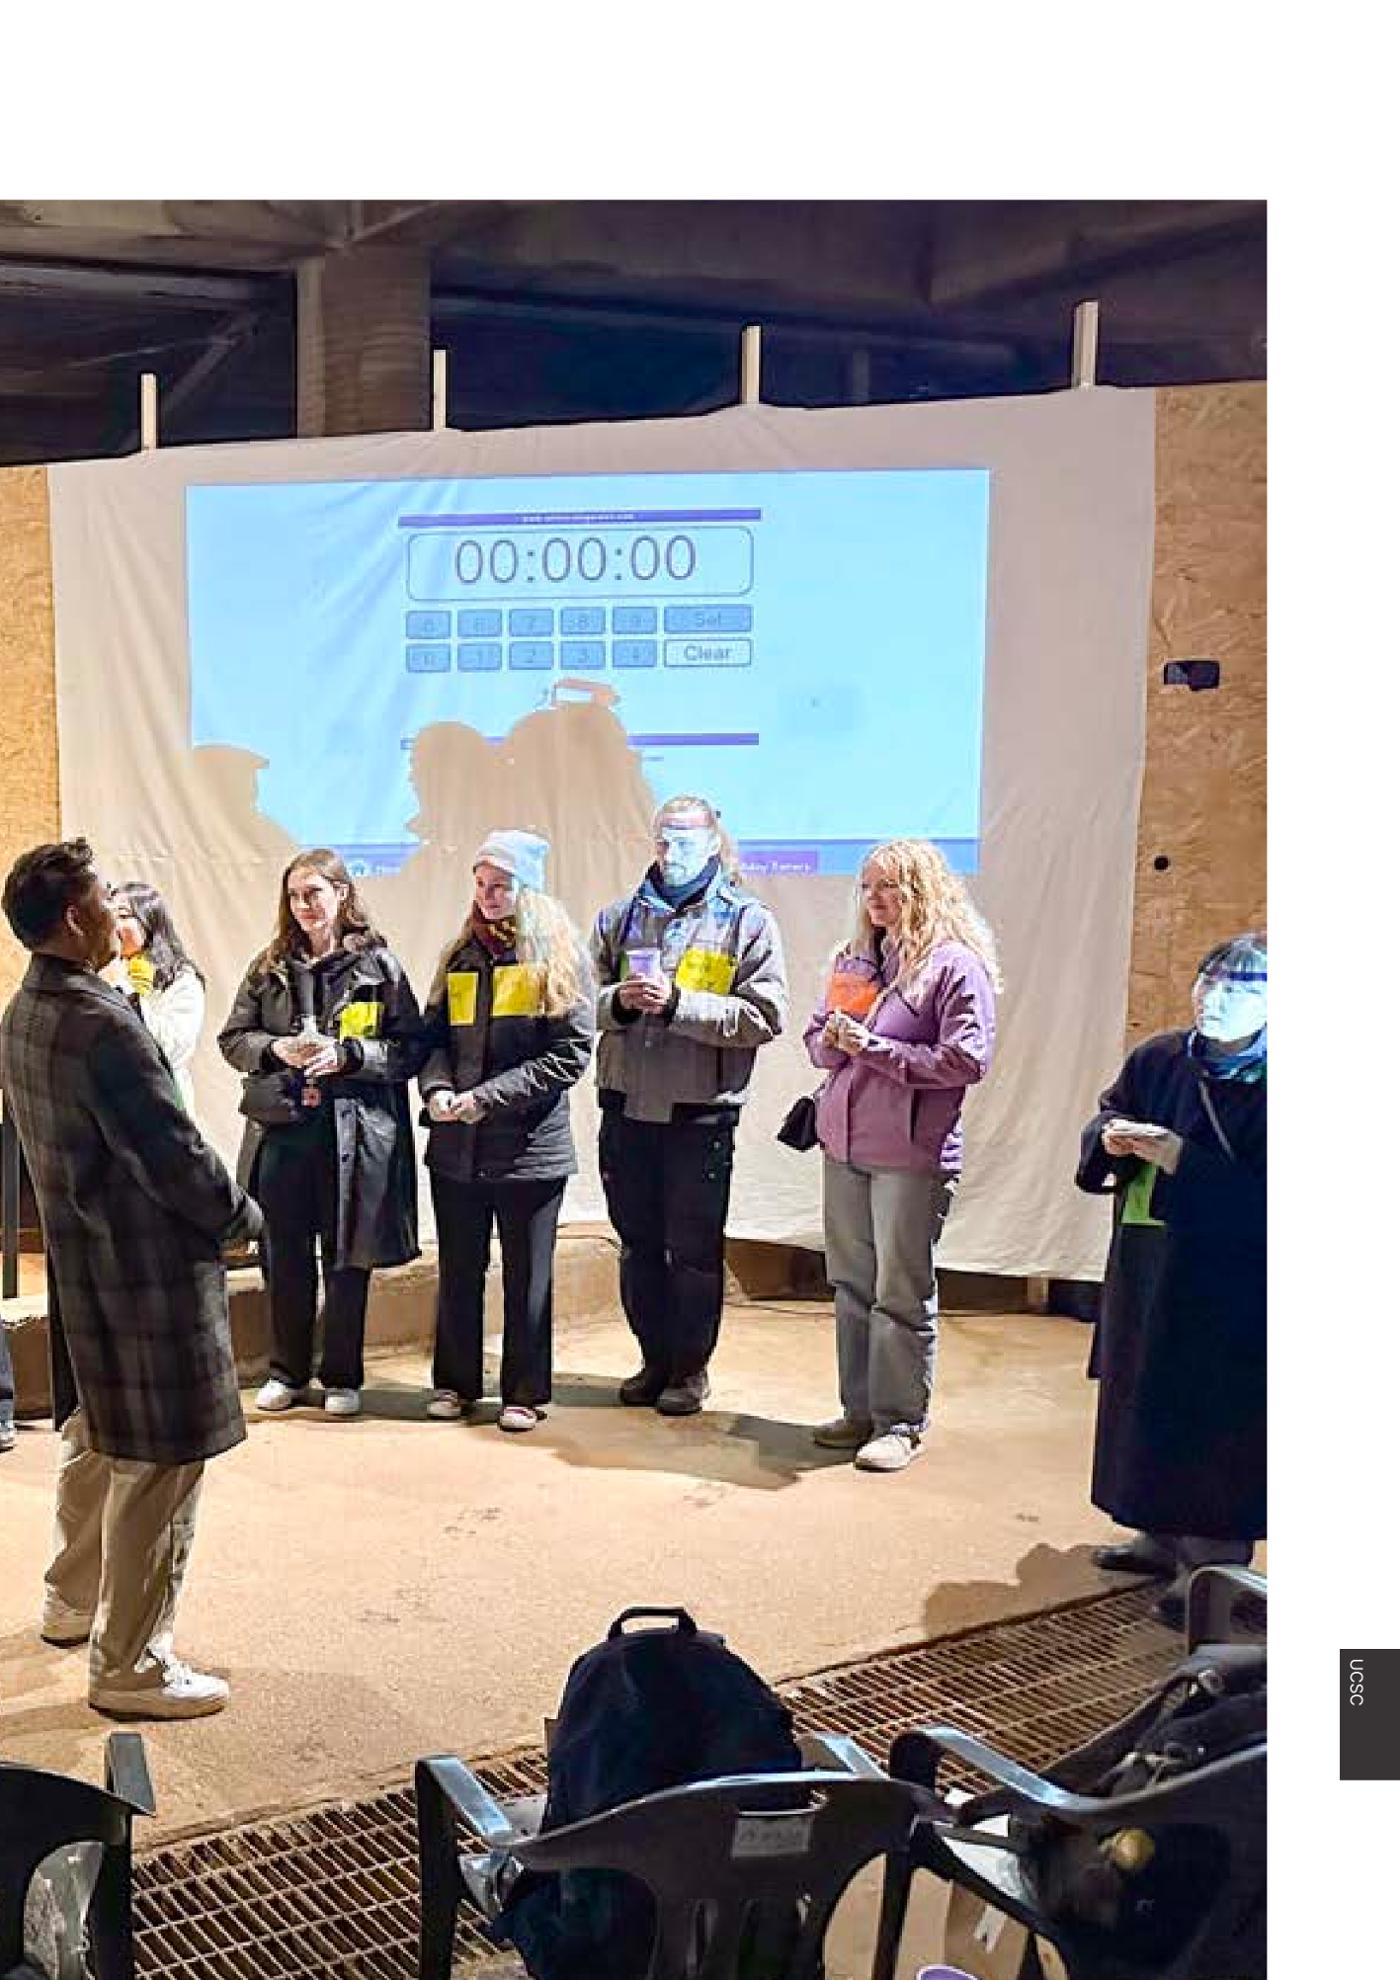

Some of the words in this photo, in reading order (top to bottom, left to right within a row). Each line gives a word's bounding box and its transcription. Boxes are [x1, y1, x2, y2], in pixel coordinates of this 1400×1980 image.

[455, 534, 697, 584] 00:00:00
[695, 610, 722, 627] Set
[683, 644, 733, 662] Clear
